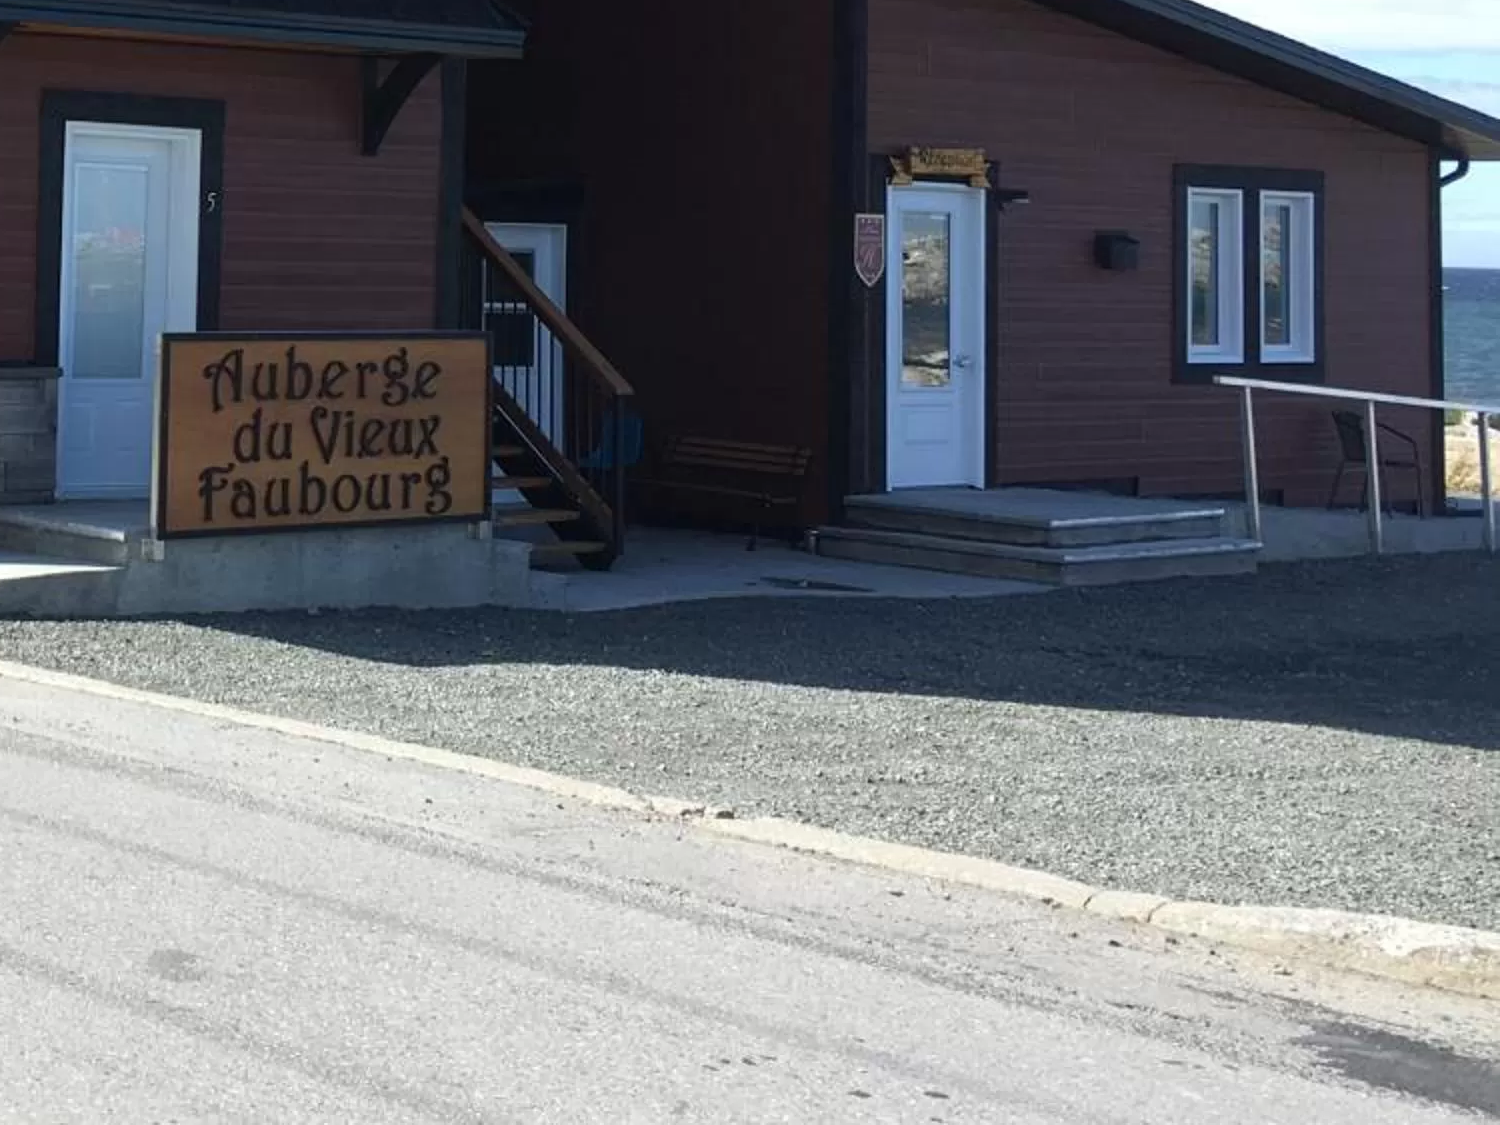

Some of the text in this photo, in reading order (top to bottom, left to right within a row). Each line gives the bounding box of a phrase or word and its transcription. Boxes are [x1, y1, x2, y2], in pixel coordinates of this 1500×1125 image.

[206, 191, 217, 212] 5
[202, 345, 442, 413] Auberge
[233, 406, 441, 465] du Vieux
[198, 456, 452, 522] Faubourg
